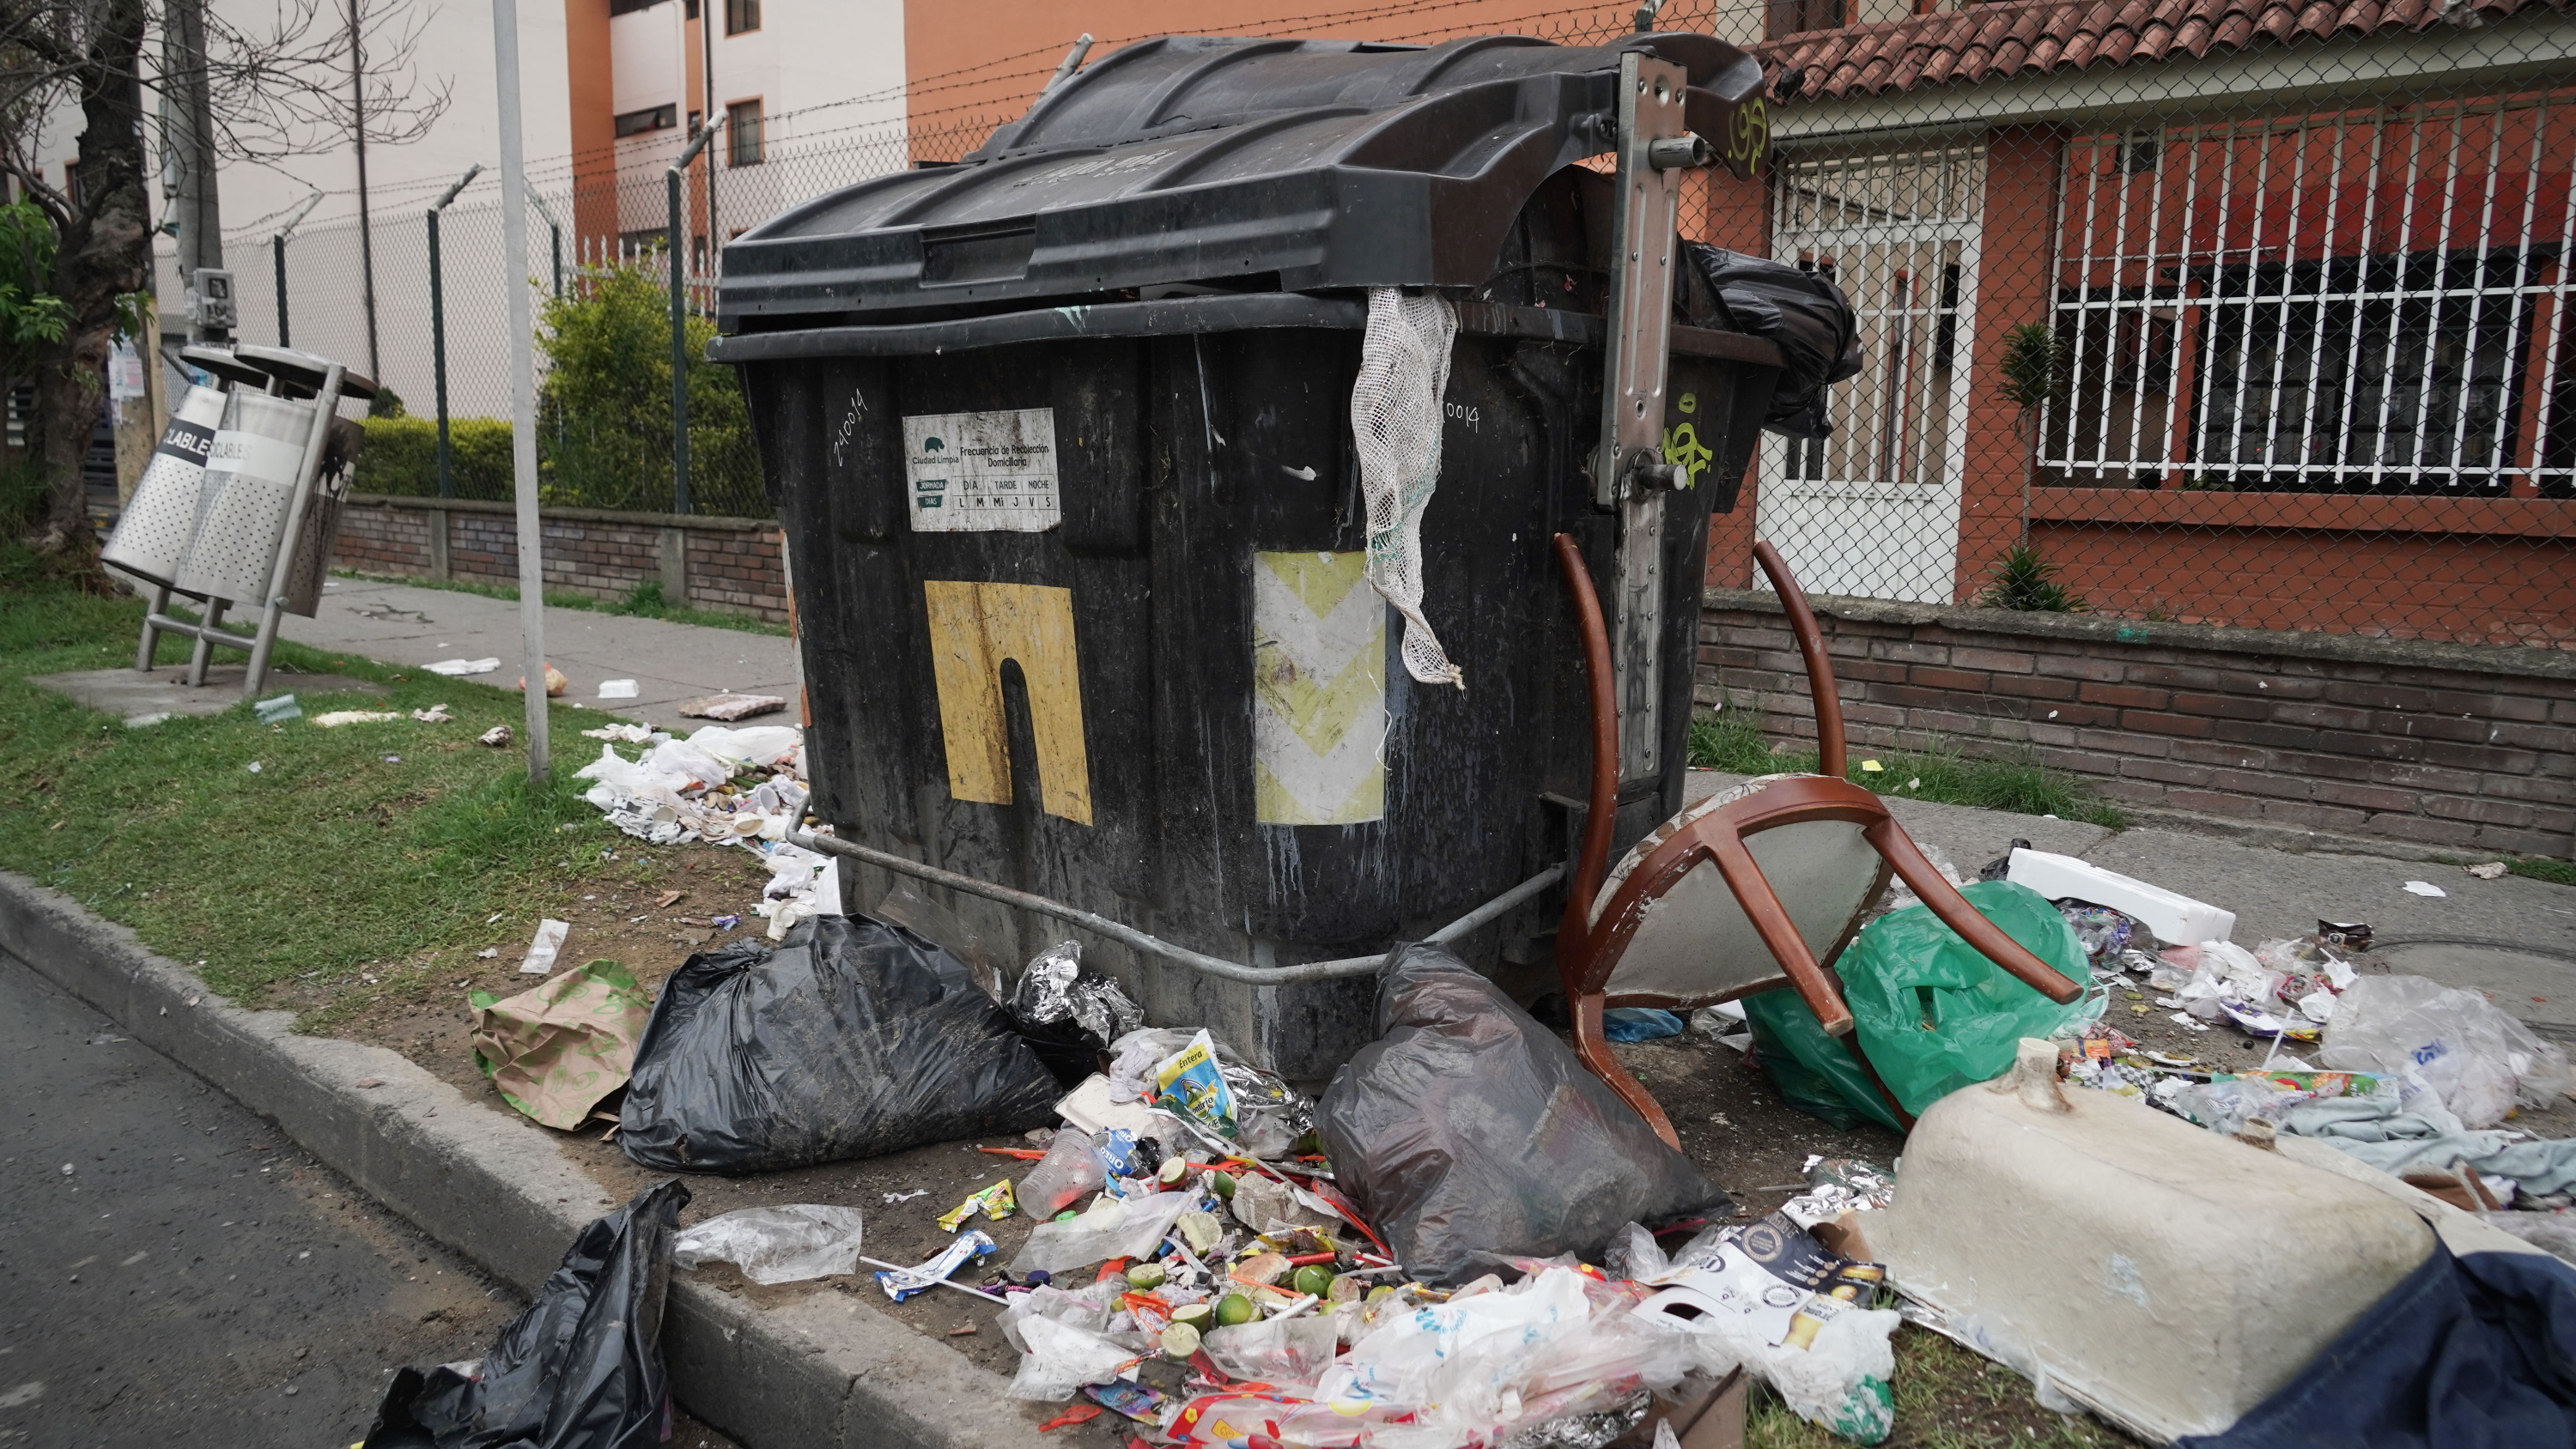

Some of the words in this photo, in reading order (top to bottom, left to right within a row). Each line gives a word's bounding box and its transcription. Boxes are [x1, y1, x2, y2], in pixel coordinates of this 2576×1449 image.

[960, 446, 999, 457] Frecuencia
[1001, 446, 1010, 455] de
[1012, 443, 1048, 455] Recolección
[912, 456, 936, 464] Ciudad
[937, 455, 959, 466] Limpia
[987, 458, 1027, 468] Domiciliaria
[919, 481, 945, 489] JORNADA
[963, 479, 979, 490] DÍA
[994, 481, 1018, 489] TARDE
[1028, 480, 1049, 489] NOCHE
[959, 497, 964, 507] L
[976, 497, 985, 507] M
[993, 497, 1004, 507] Mi
[1012, 497, 1018, 506] J
[1028, 497, 1035, 506] V
[1046, 497, 1051, 506] S
[1179, 1050, 1203, 1070] Entera
[1100, 1146, 1124, 1169] OREO
